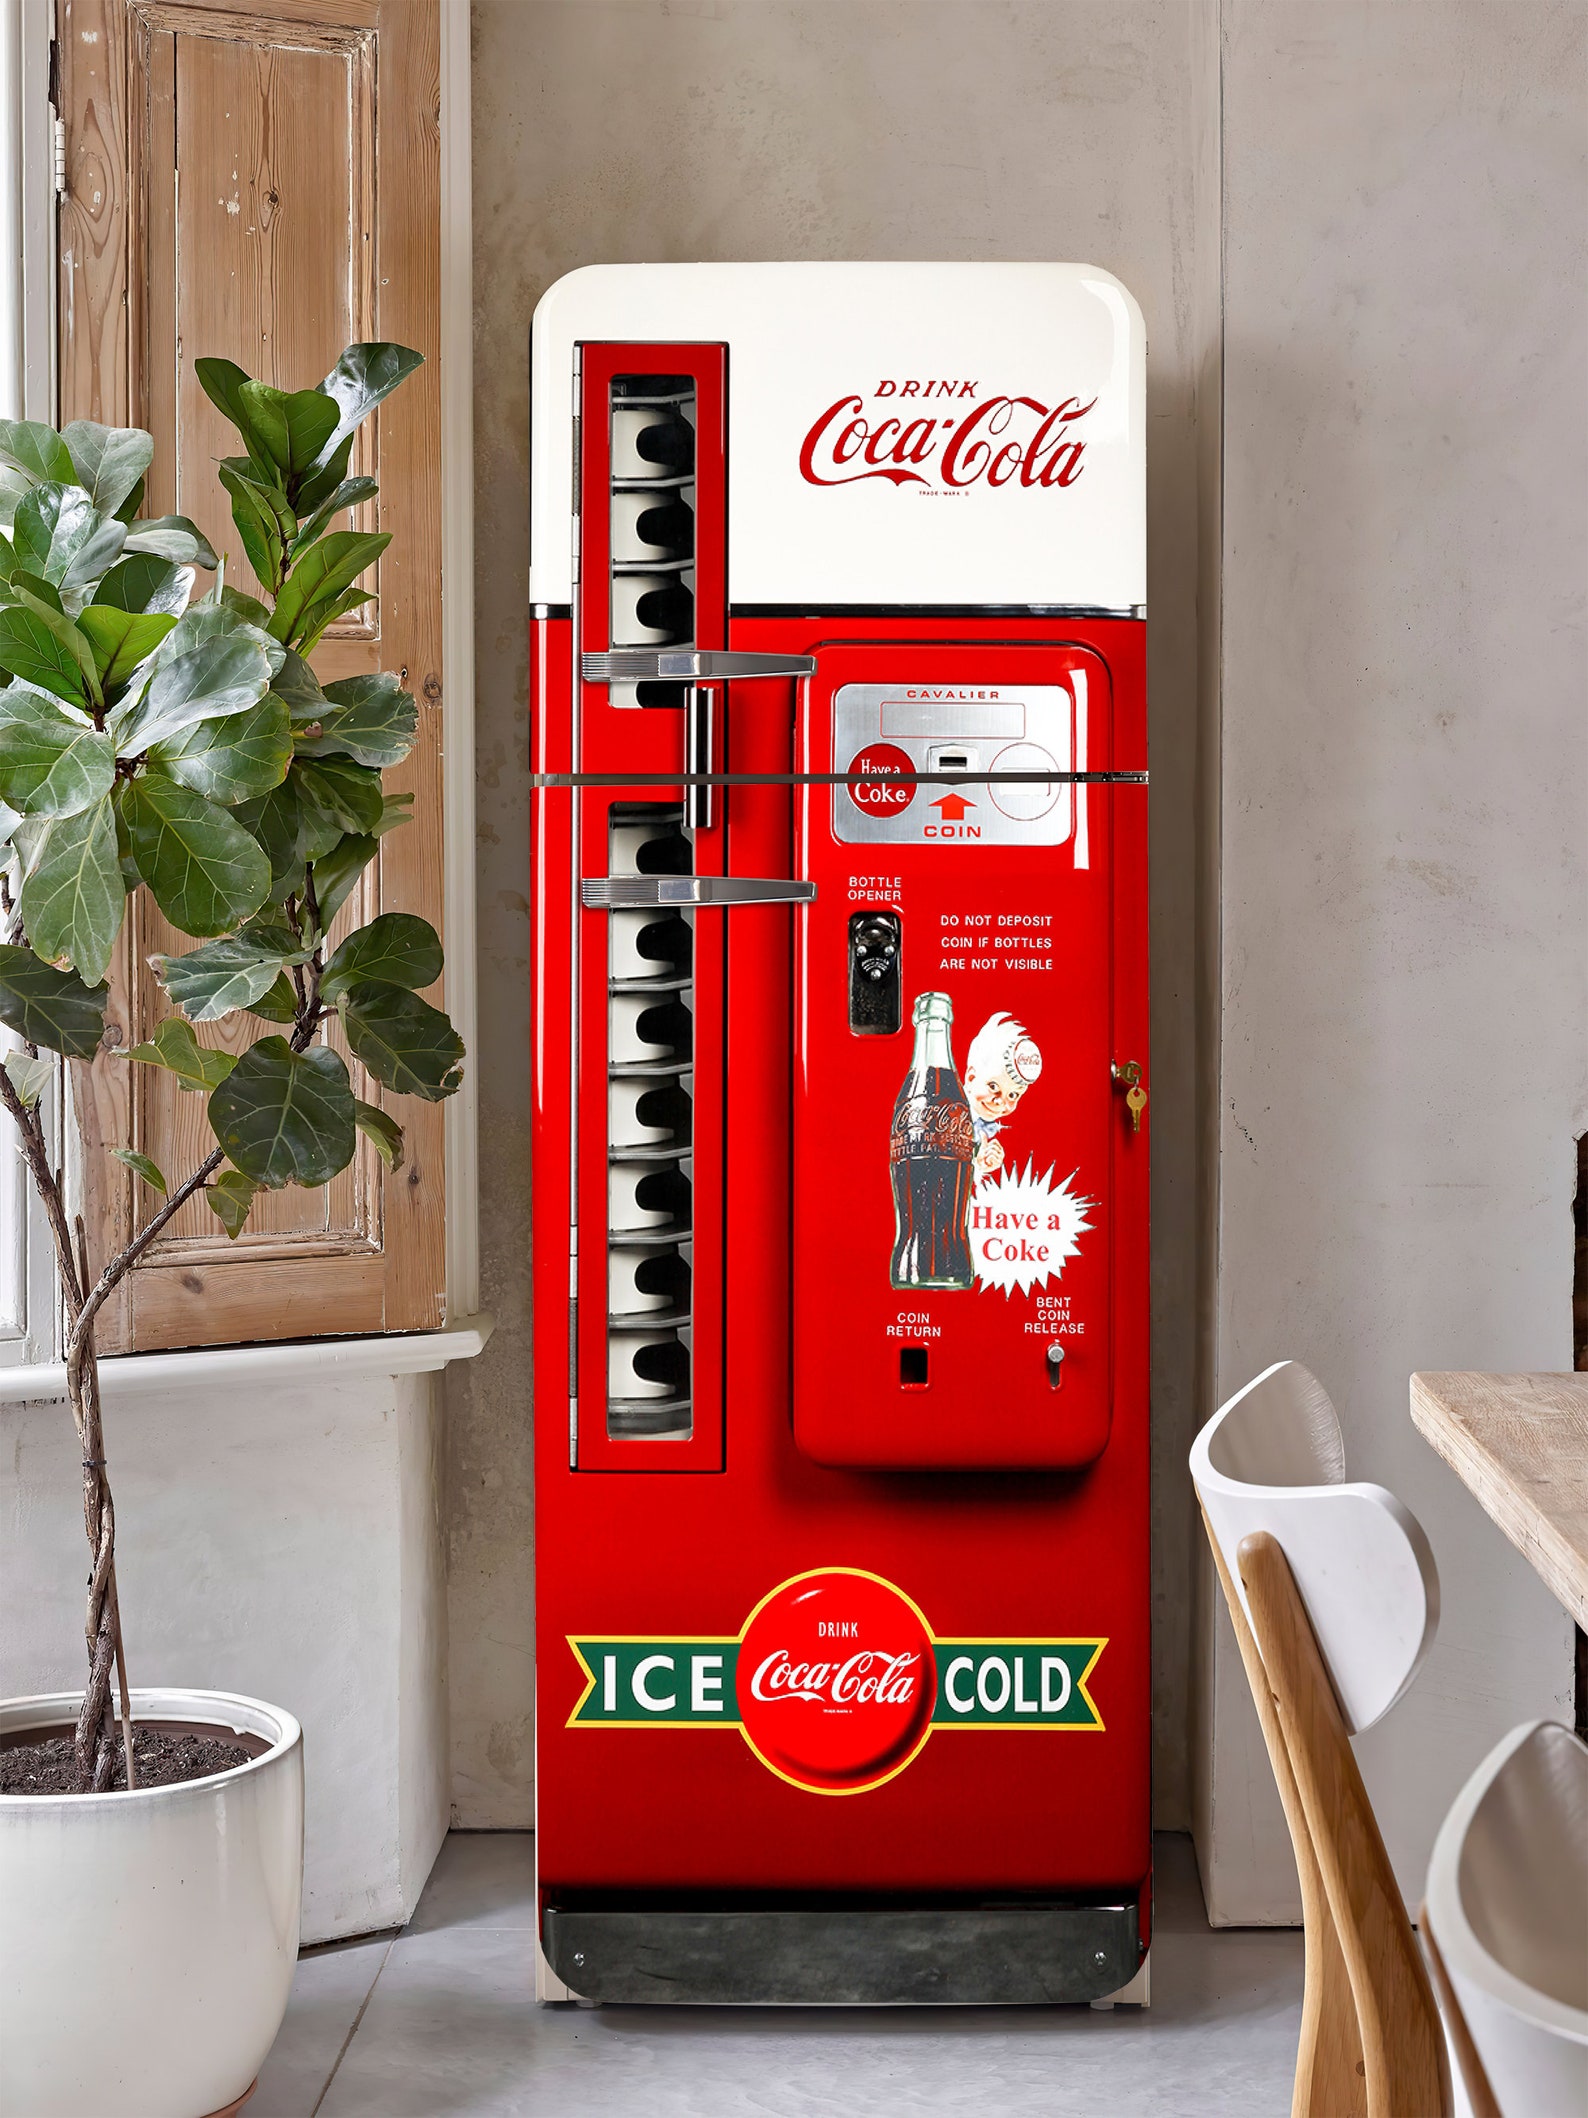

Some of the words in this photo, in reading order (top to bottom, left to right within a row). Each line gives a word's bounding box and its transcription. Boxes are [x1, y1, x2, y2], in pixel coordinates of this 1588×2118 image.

[874, 379, 979, 398] DRINK
[799, 394, 1098, 488] Coca-Cola
[906, 689, 1000, 699] CAVALIER
[860, 758, 892, 774] Have
[892, 765, 901, 774] a
[923, 824, 982, 838] COIN
[848, 876, 902, 888] BOTTLE
[847, 890, 902, 902] OPENER
[940, 914, 960, 927] DO
[964, 914, 993, 927] NOT
[997, 914, 1053, 927] DEPOSIT
[941, 936, 973, 949] COIN
[978, 936, 989, 949] IF
[994, 936, 1052, 949] BOTTLES
[939, 958, 966, 970] ARE
[971, 958, 999, 970] NOT
[1004, 958, 1053, 970] VISIBLE
[972, 1206, 1039, 1231] Have
[1046, 1213, 1061, 1231] a
[981, 1237, 1050, 1263] Coke
[1036, 1296, 1072, 1308] BENT
[896, 1312, 930, 1324] COIN
[1037, 1309, 1071, 1321] COIN
[886, 1326, 941, 1338] RETURN
[1024, 1322, 1085, 1334] RELEASE
[818, 1621, 859, 1638] DRINK
[750, 1649, 921, 1704] Coca-Cola
[603, 1655, 724, 1712] ICE
[944, 1656, 1072, 1714] COLD
